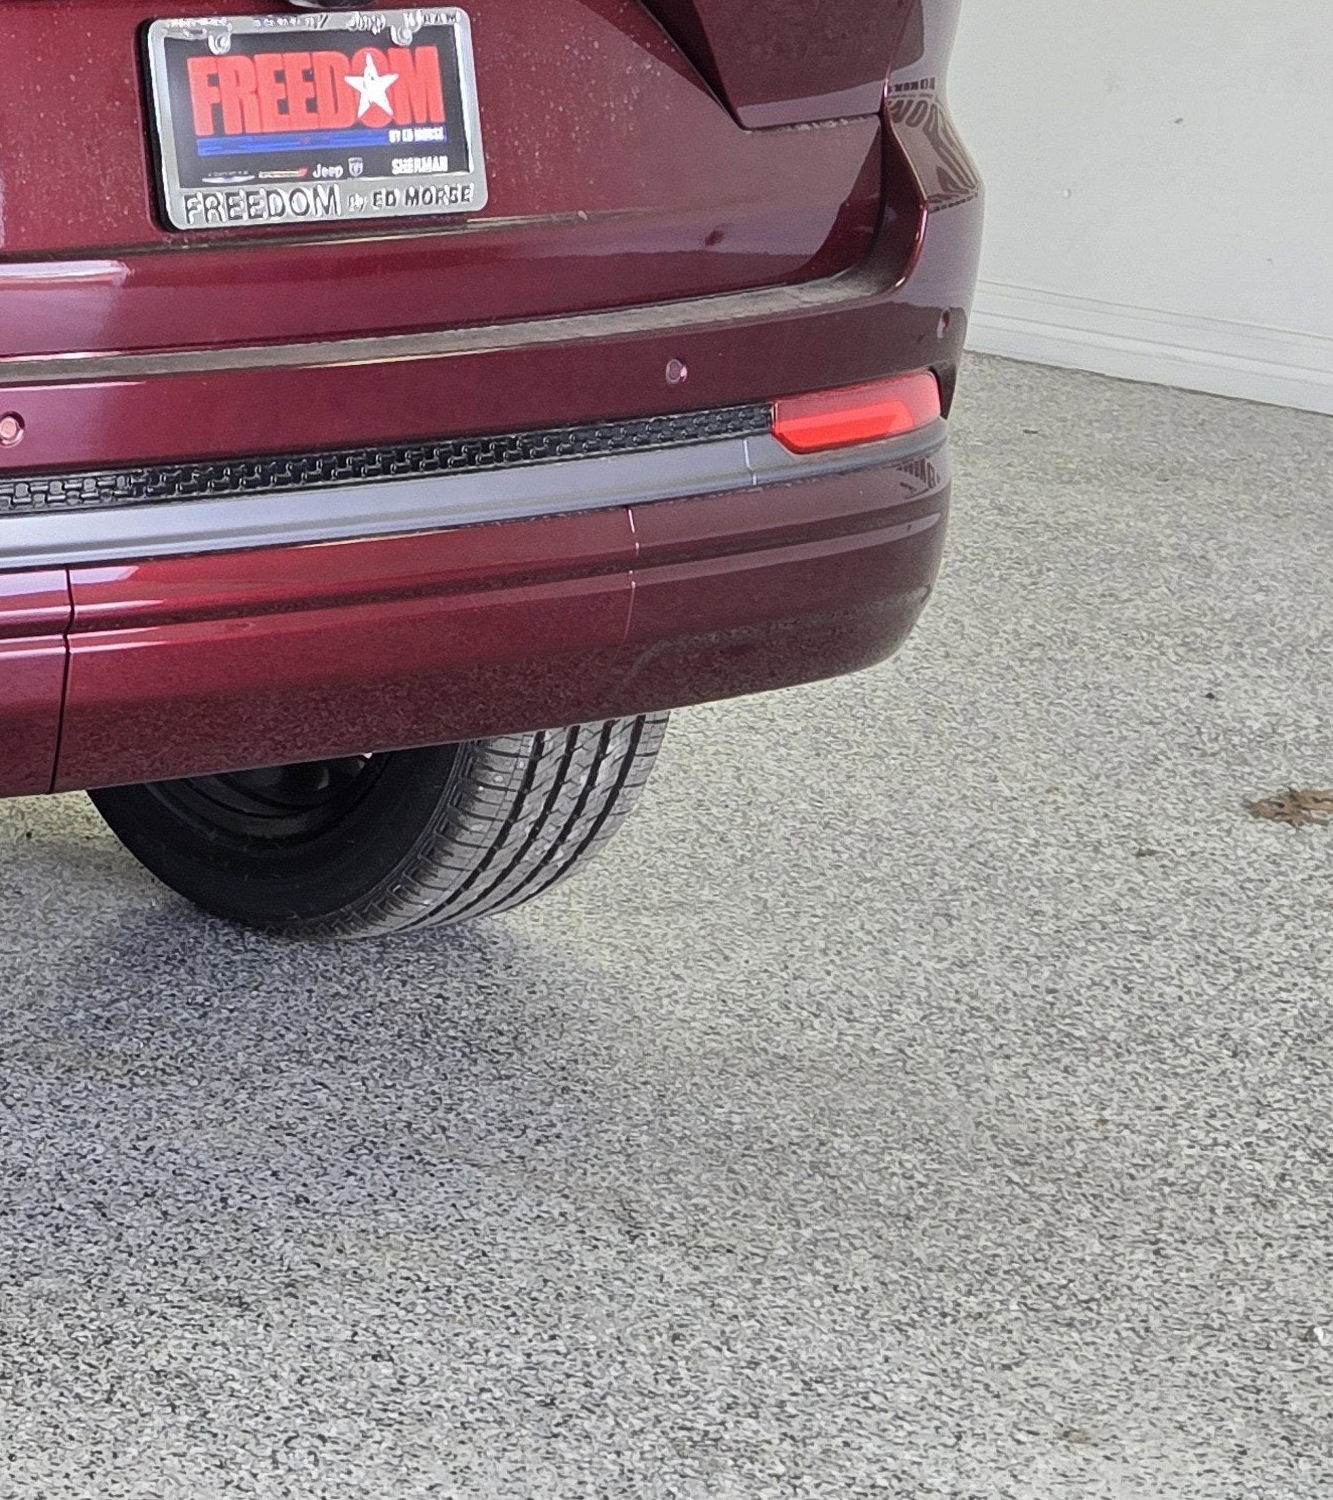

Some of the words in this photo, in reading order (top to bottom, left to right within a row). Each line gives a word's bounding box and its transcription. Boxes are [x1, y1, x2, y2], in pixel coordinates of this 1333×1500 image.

[187, 45, 445, 137] FREEDOM
[391, 155, 449, 175] SHERMAN
[184, 182, 342, 225] FREEDOM
[372, 188, 401, 208] ED
